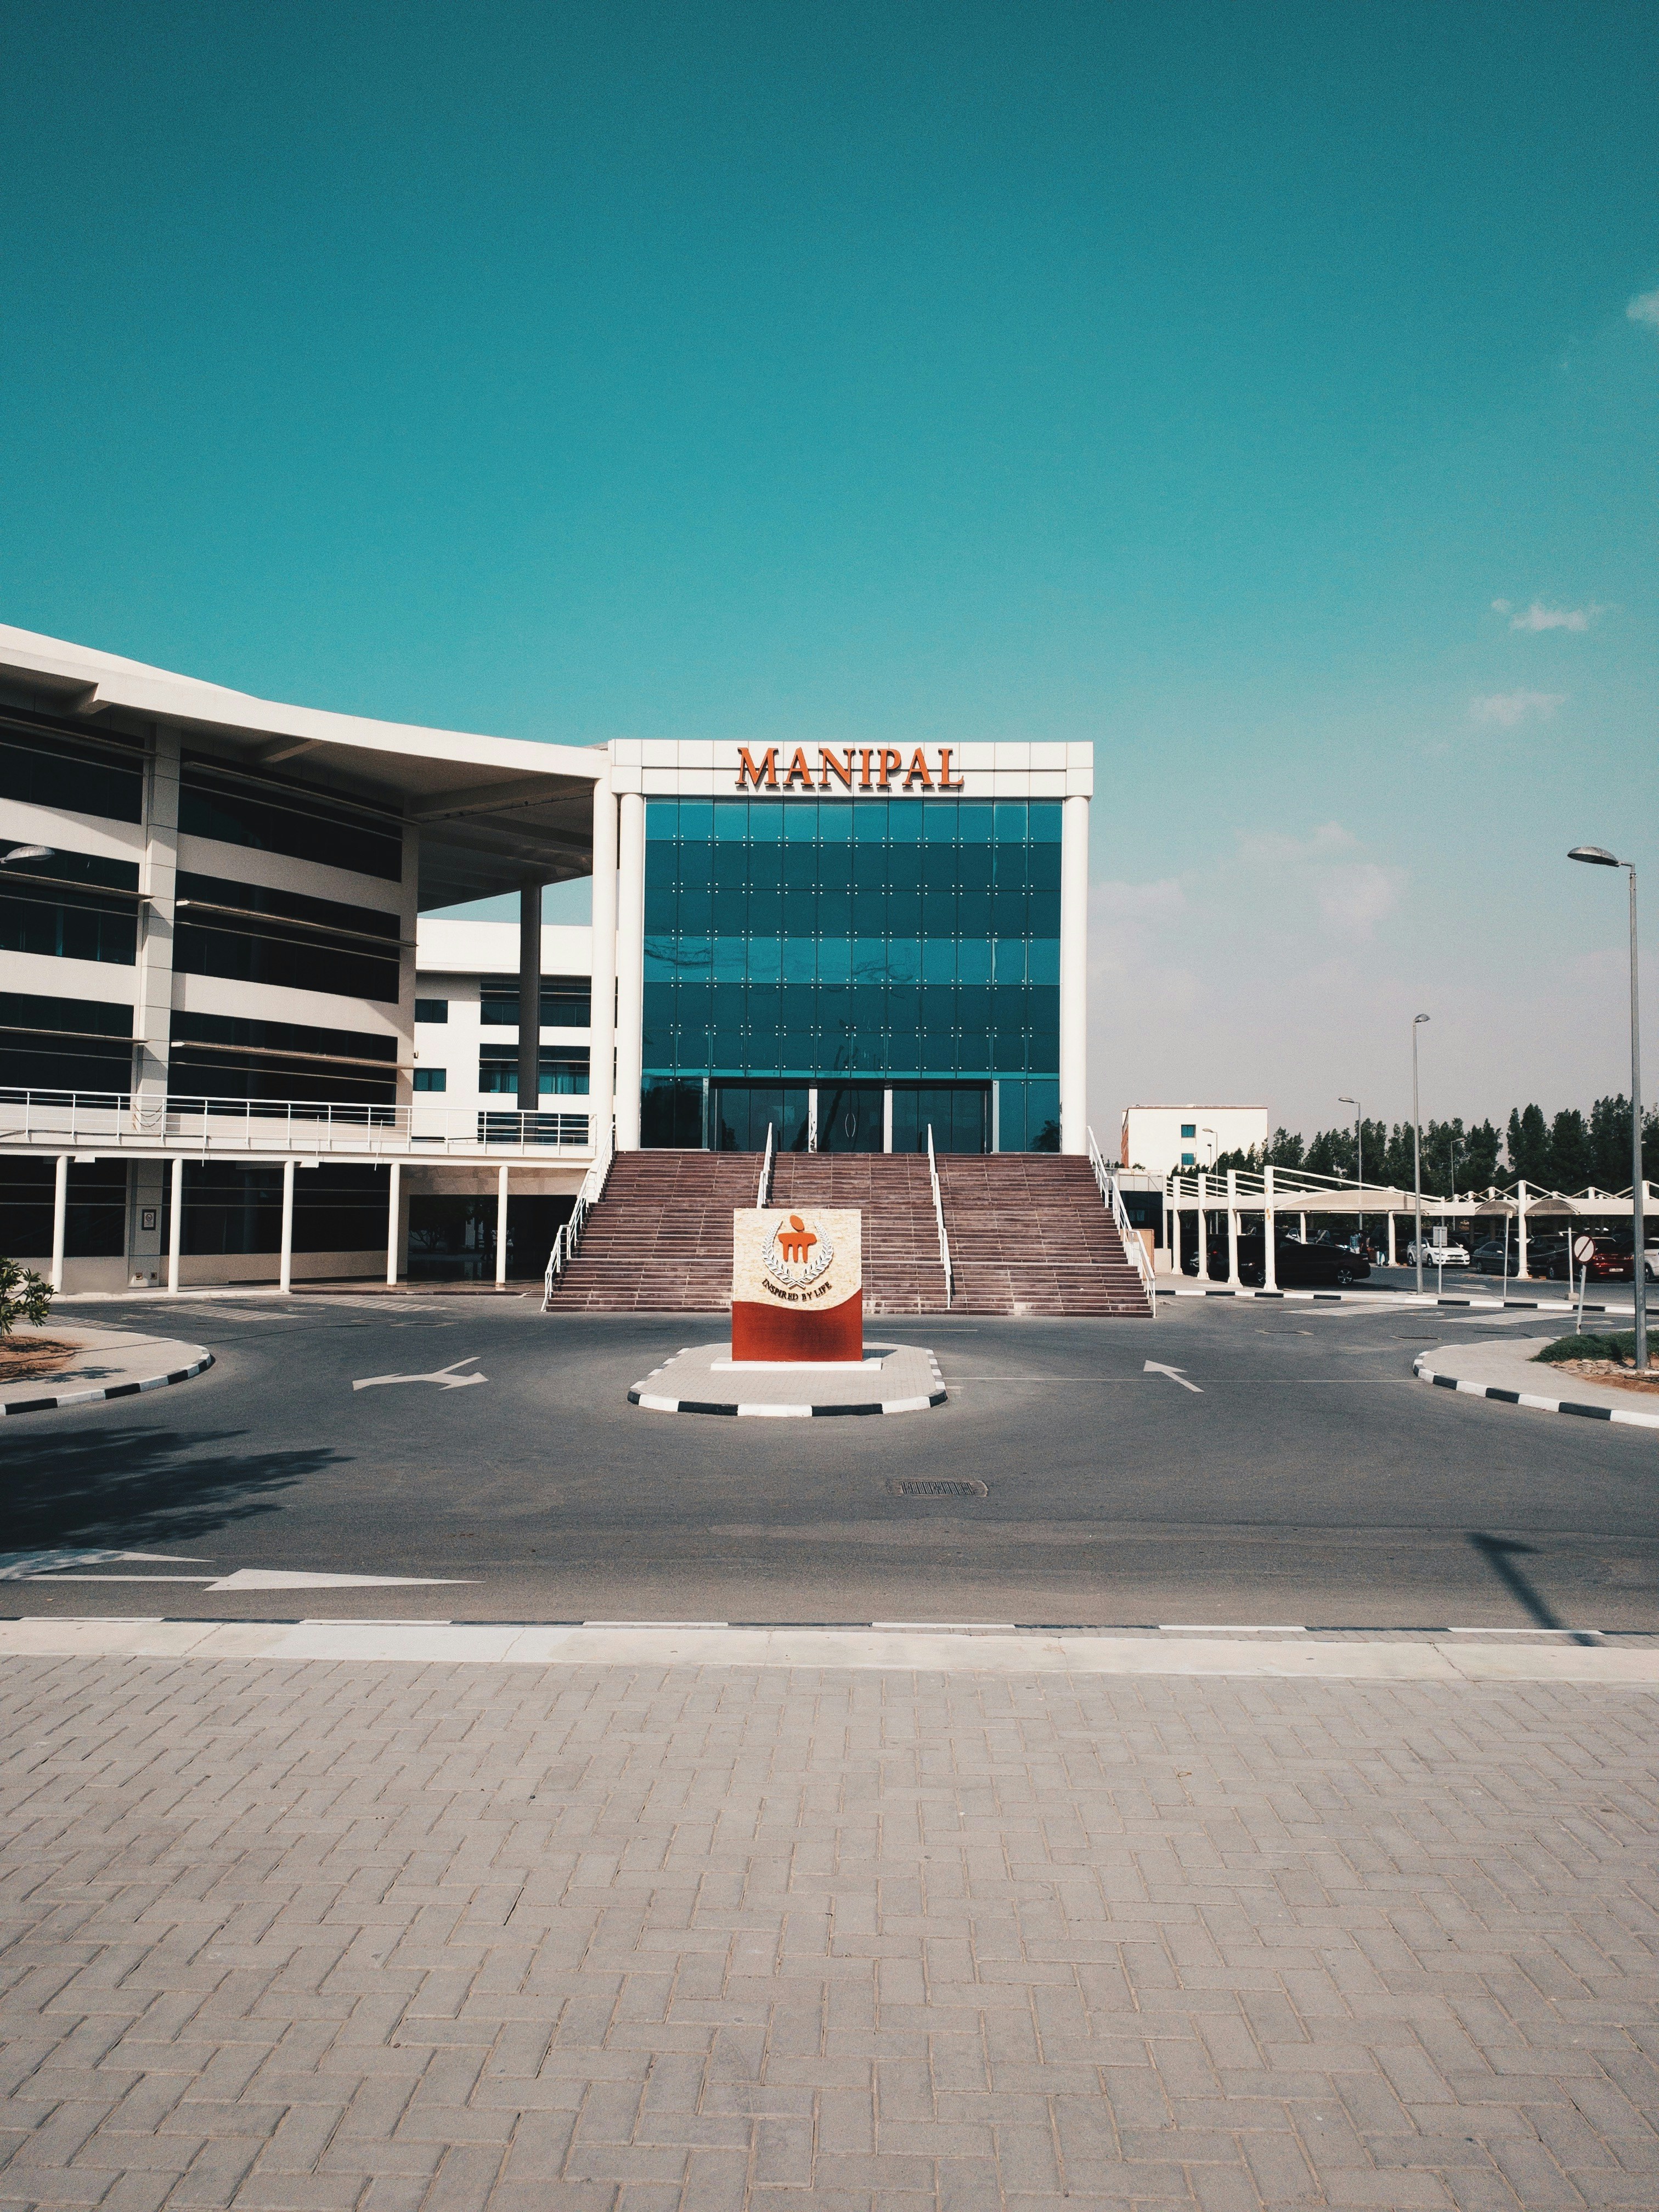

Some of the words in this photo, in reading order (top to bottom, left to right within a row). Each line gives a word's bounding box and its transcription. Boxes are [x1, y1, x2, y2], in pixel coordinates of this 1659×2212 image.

[735, 747, 964, 786] MANIPAL
[762, 1278, 799, 1300] INSPIRED
[802, 1291, 812, 1301] BY
[814, 1281, 832, 1297] LIFE
